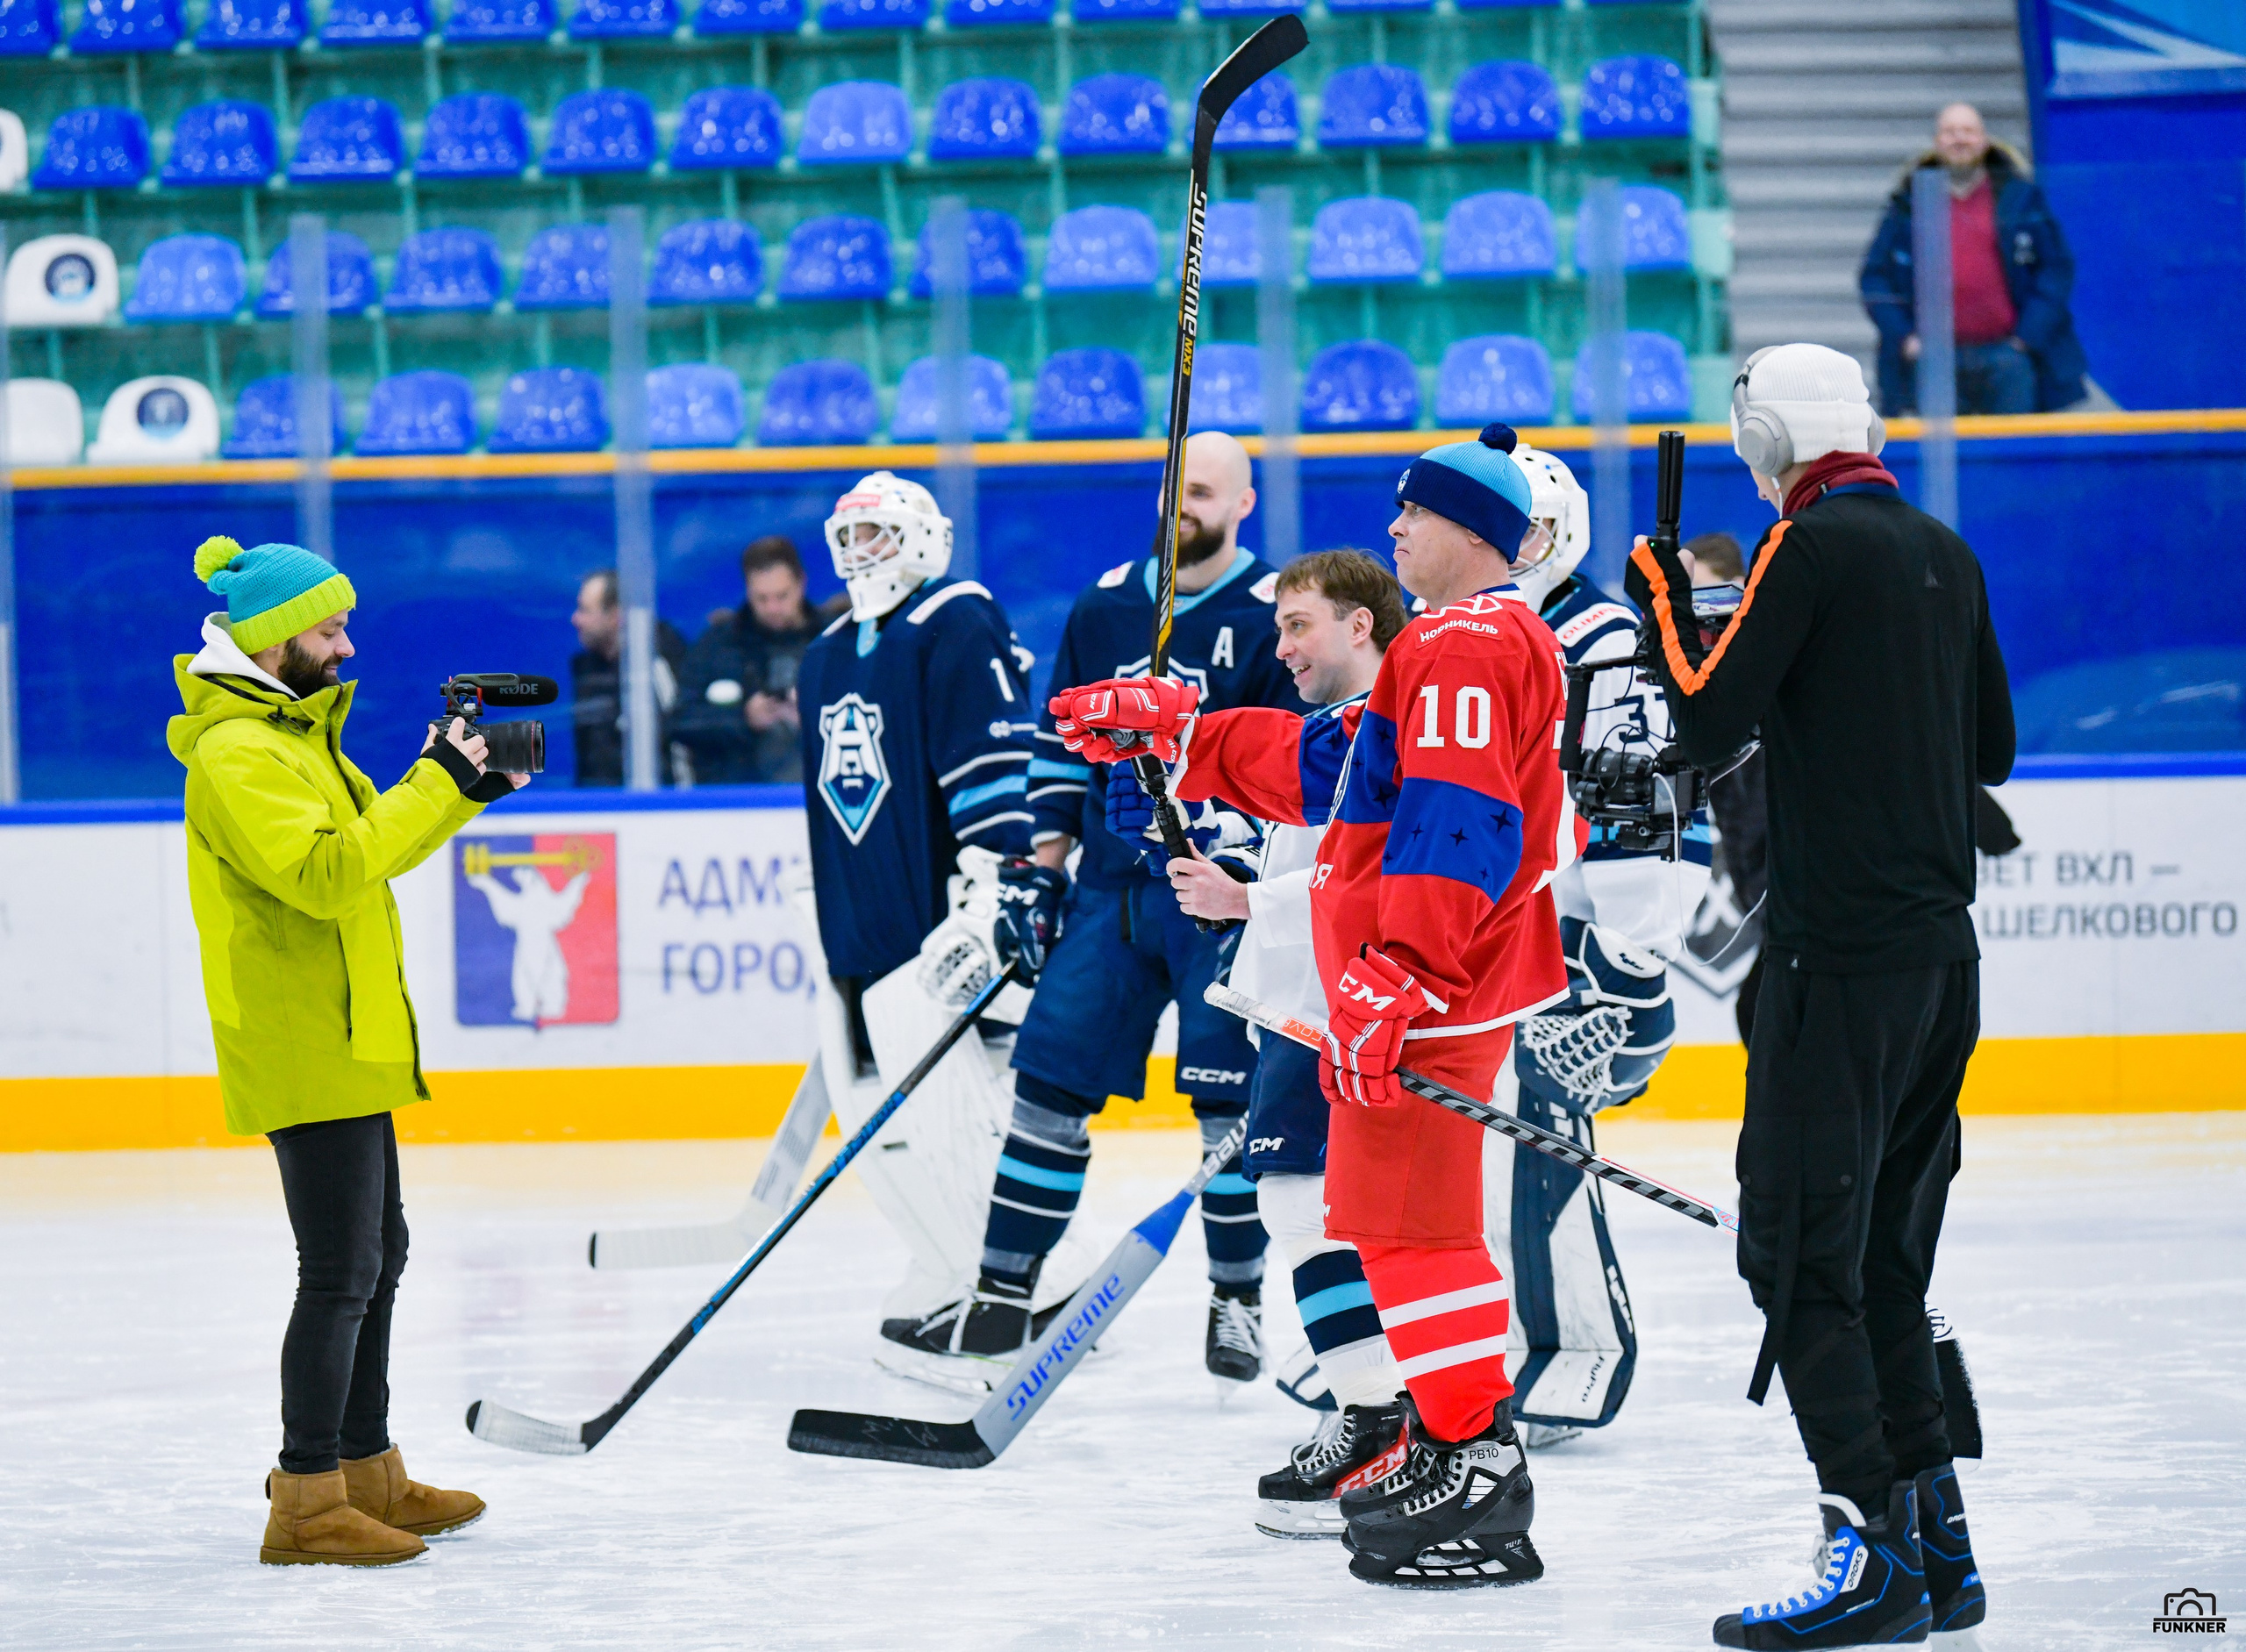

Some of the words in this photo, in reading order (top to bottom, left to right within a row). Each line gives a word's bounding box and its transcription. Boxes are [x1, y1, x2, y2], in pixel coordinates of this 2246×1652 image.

[1183, 182, 1207, 336] SUPREME
[1182, 338, 1194, 376] MX3
[1211, 626, 1234, 669] A
[1420, 619, 1499, 642] НОРНИКЕЛЬ
[1416, 684, 1491, 749] 10
[658, 856, 799, 916] АДМ
[2056, 849, 2135, 886] ВХЛ
[1982, 901, 2238, 940] ШЕЛКОВОГО
[1181, 1066, 1247, 1085] CCM
[1007, 1272, 1126, 1421] SUPREME
[1469, 1448, 1499, 1460] PB10
[1848, 1549, 1863, 1588] DROKS
